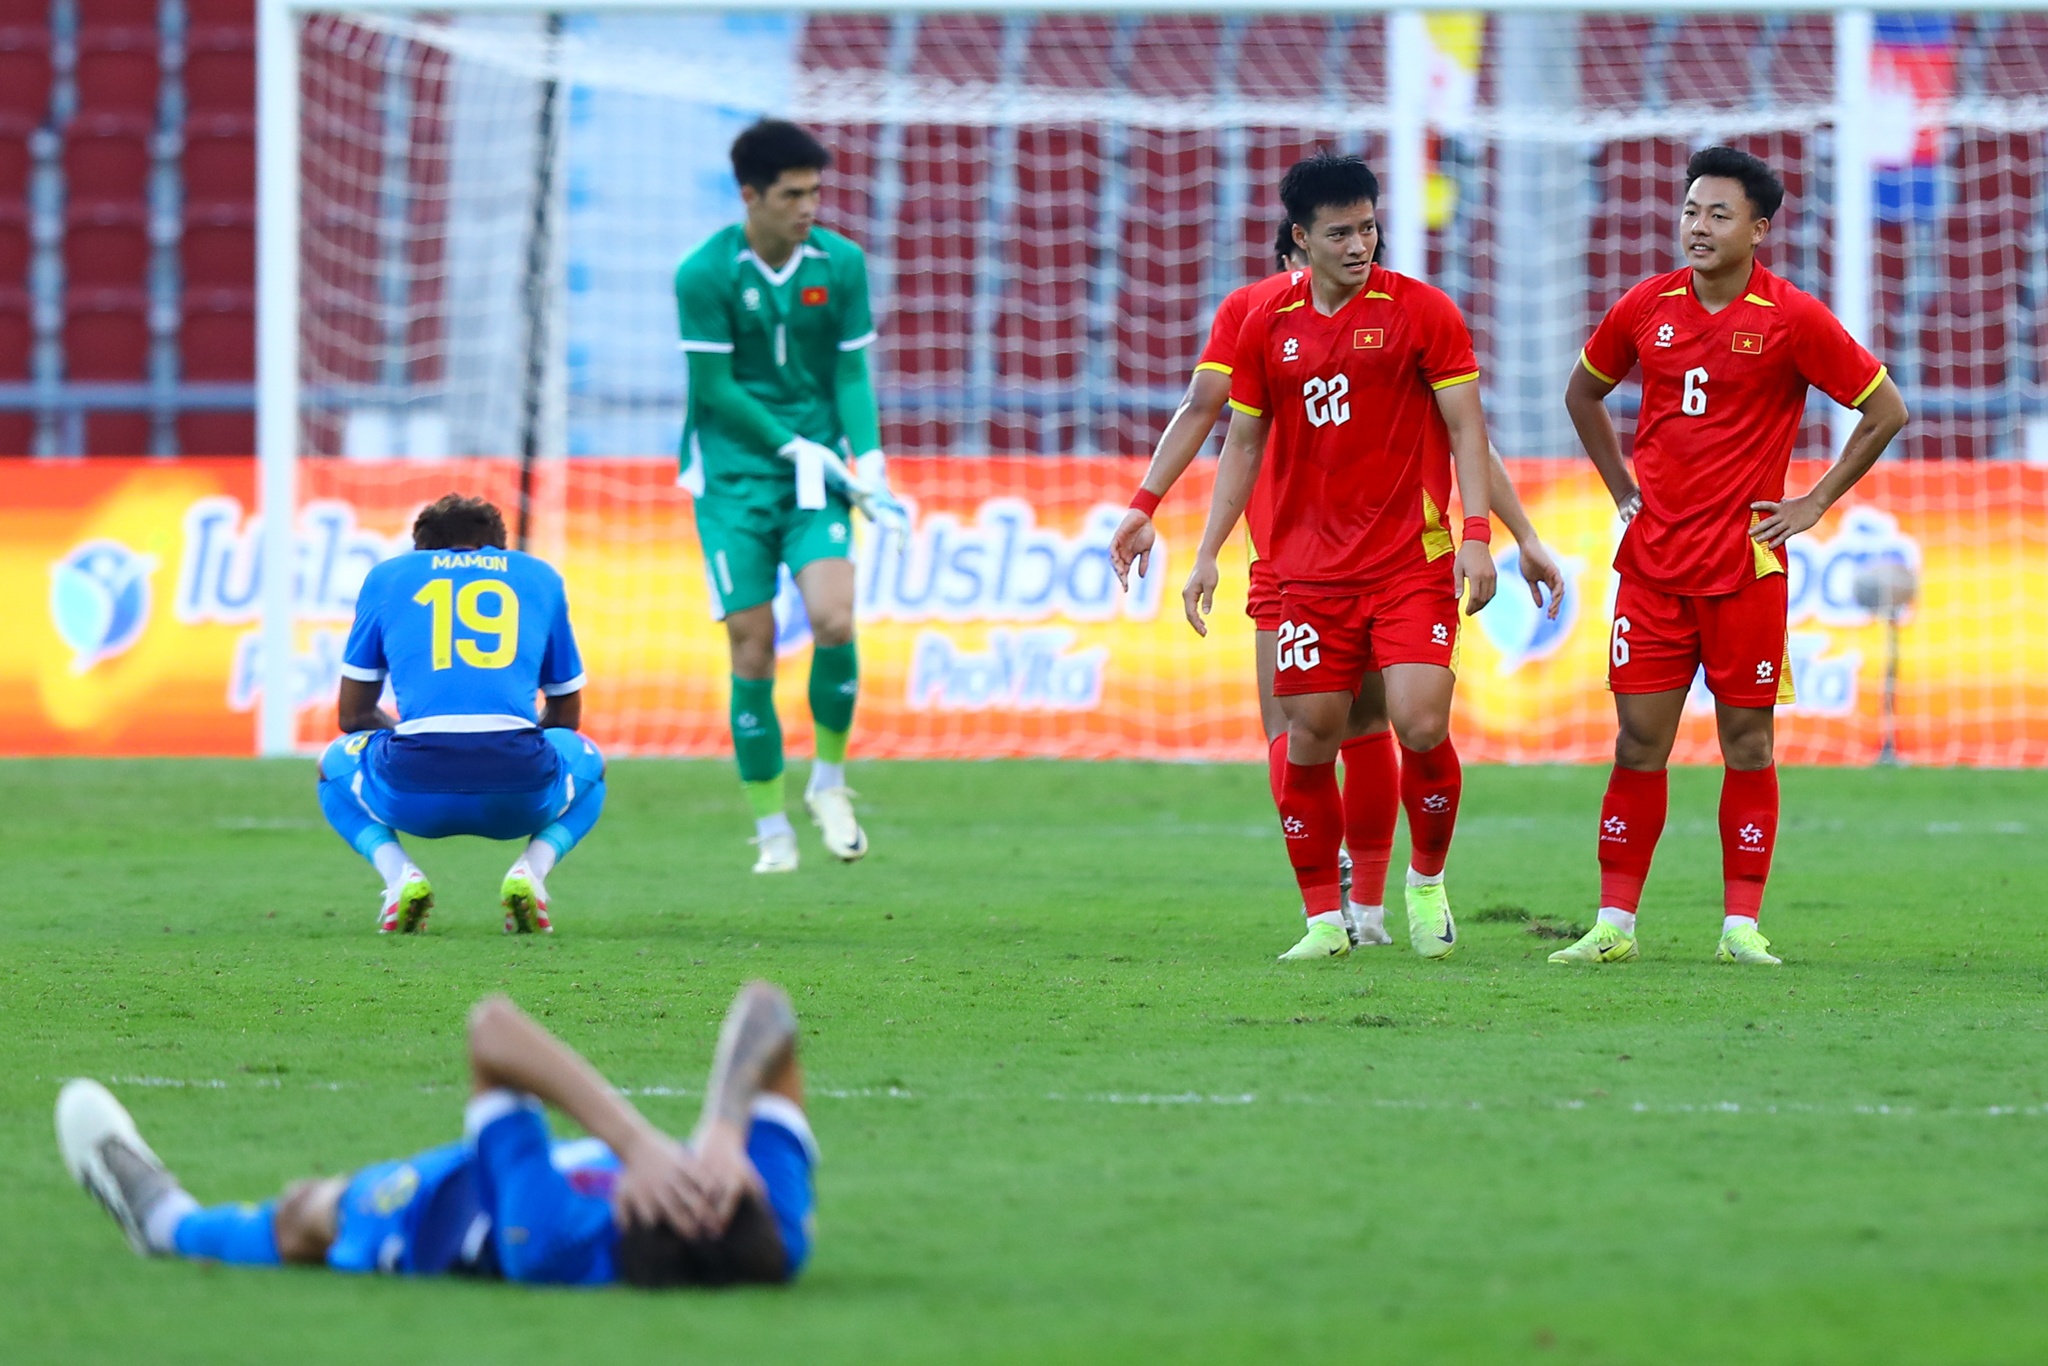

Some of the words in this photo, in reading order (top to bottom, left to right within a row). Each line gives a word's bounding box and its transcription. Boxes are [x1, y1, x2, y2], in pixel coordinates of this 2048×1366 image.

[1303, 373, 1351, 428] 22
[1681, 366, 1709, 416] 6
[431, 555, 508, 572] MAMON
[412, 578, 520, 671] 19
[1276, 619, 1321, 672] 22
[1612, 615, 1631, 668] 6
